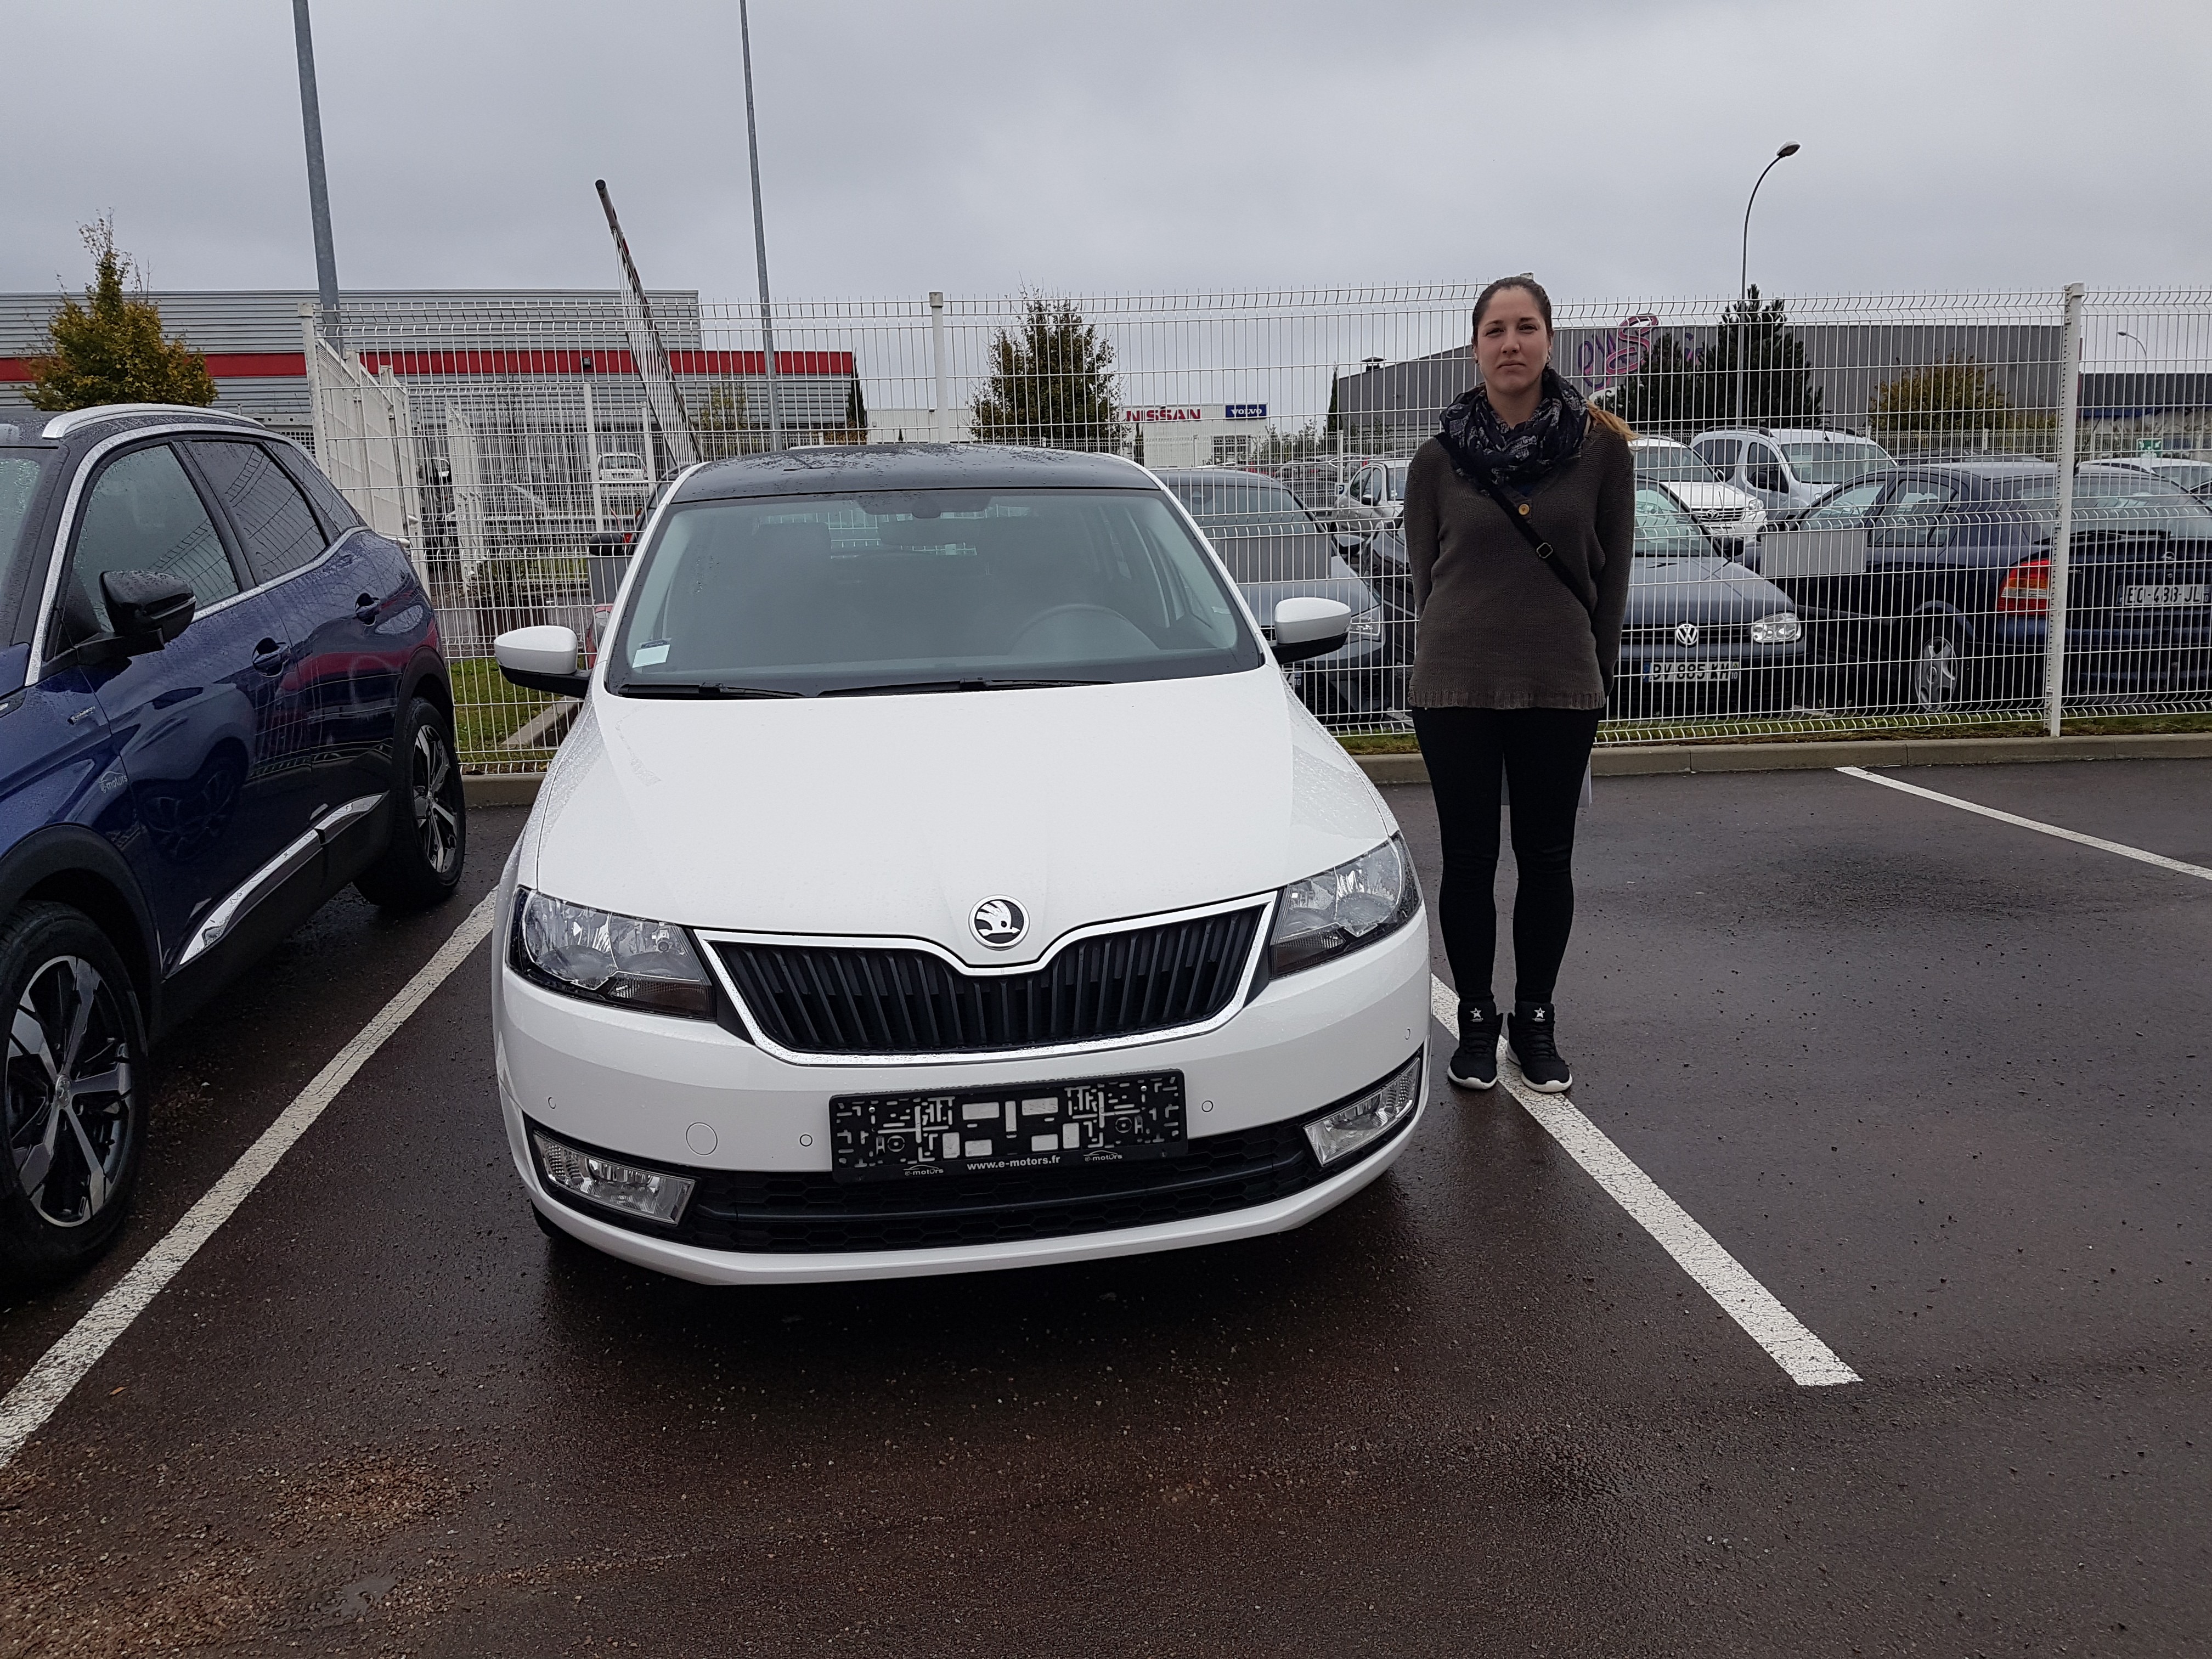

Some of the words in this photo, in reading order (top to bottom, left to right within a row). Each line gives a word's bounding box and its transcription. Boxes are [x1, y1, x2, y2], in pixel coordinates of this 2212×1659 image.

[1126, 409, 1200, 421] NISSAN
[1731, 671, 1739, 680] 10
[967, 1155, 1061, 1171] www.e-motors.fr
